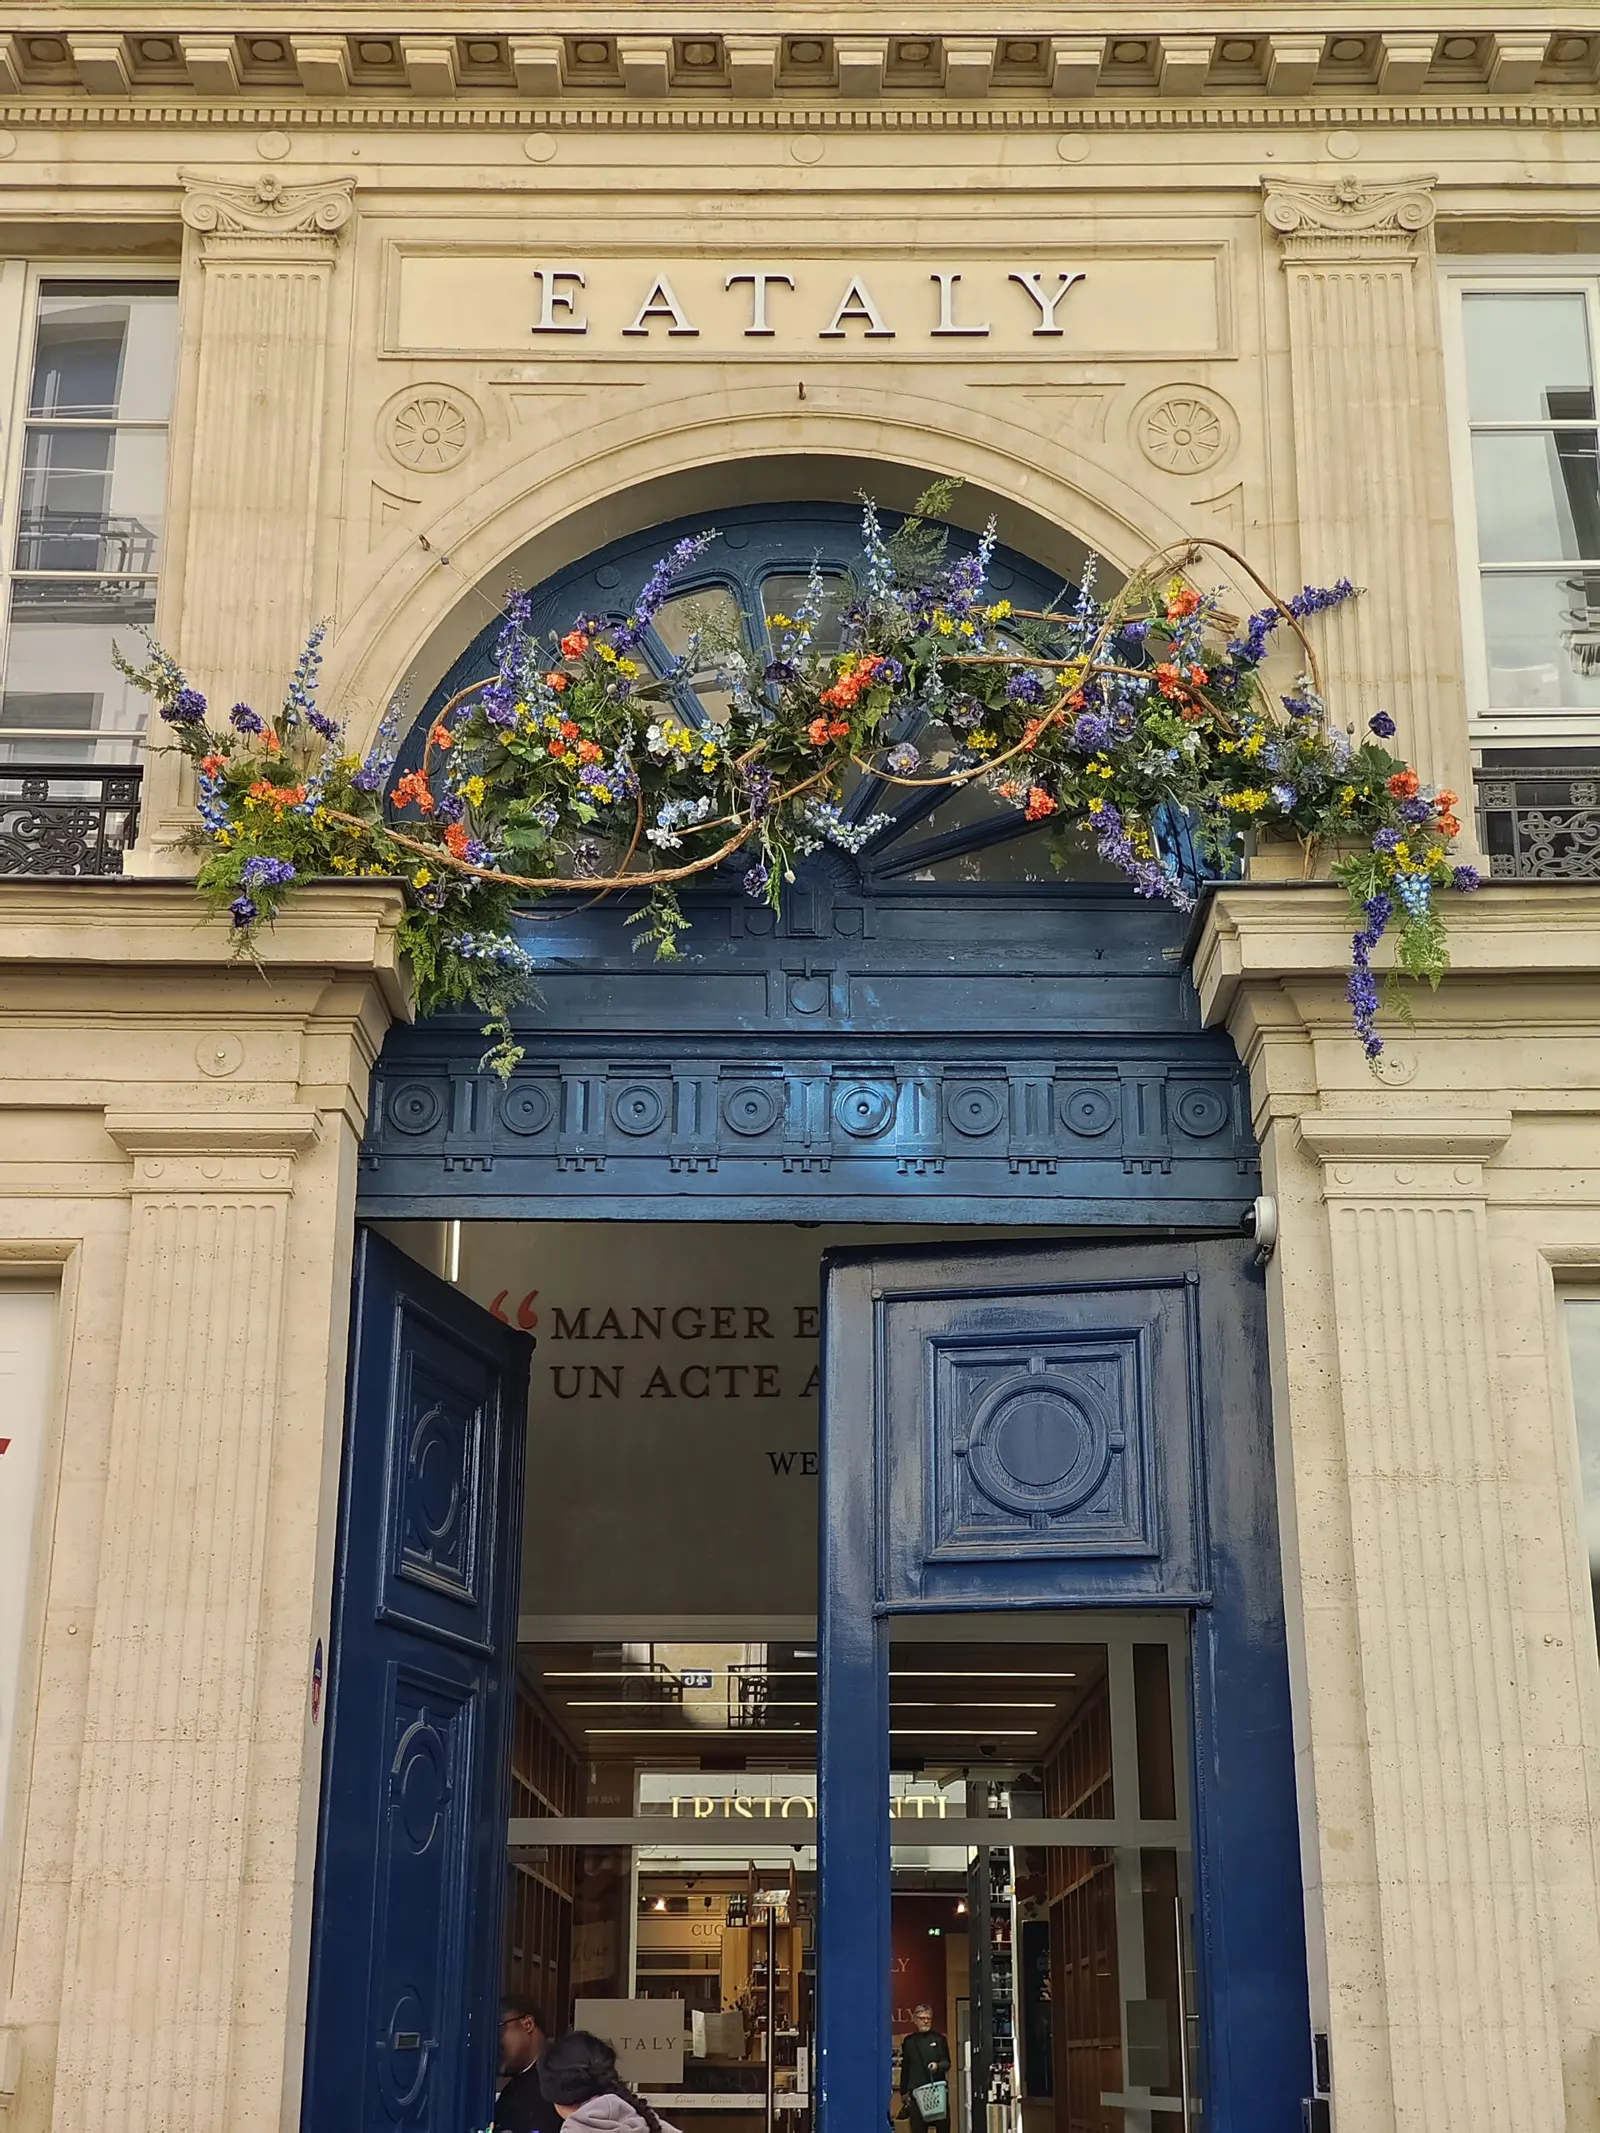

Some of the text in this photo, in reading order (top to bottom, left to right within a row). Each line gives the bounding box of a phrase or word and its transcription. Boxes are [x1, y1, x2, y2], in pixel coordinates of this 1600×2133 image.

[531, 269, 1086, 338] EATALY
[550, 1306, 774, 1340] MANGER
[550, 1365, 624, 1399] UN
[640, 1365, 781, 1399] ACTE
